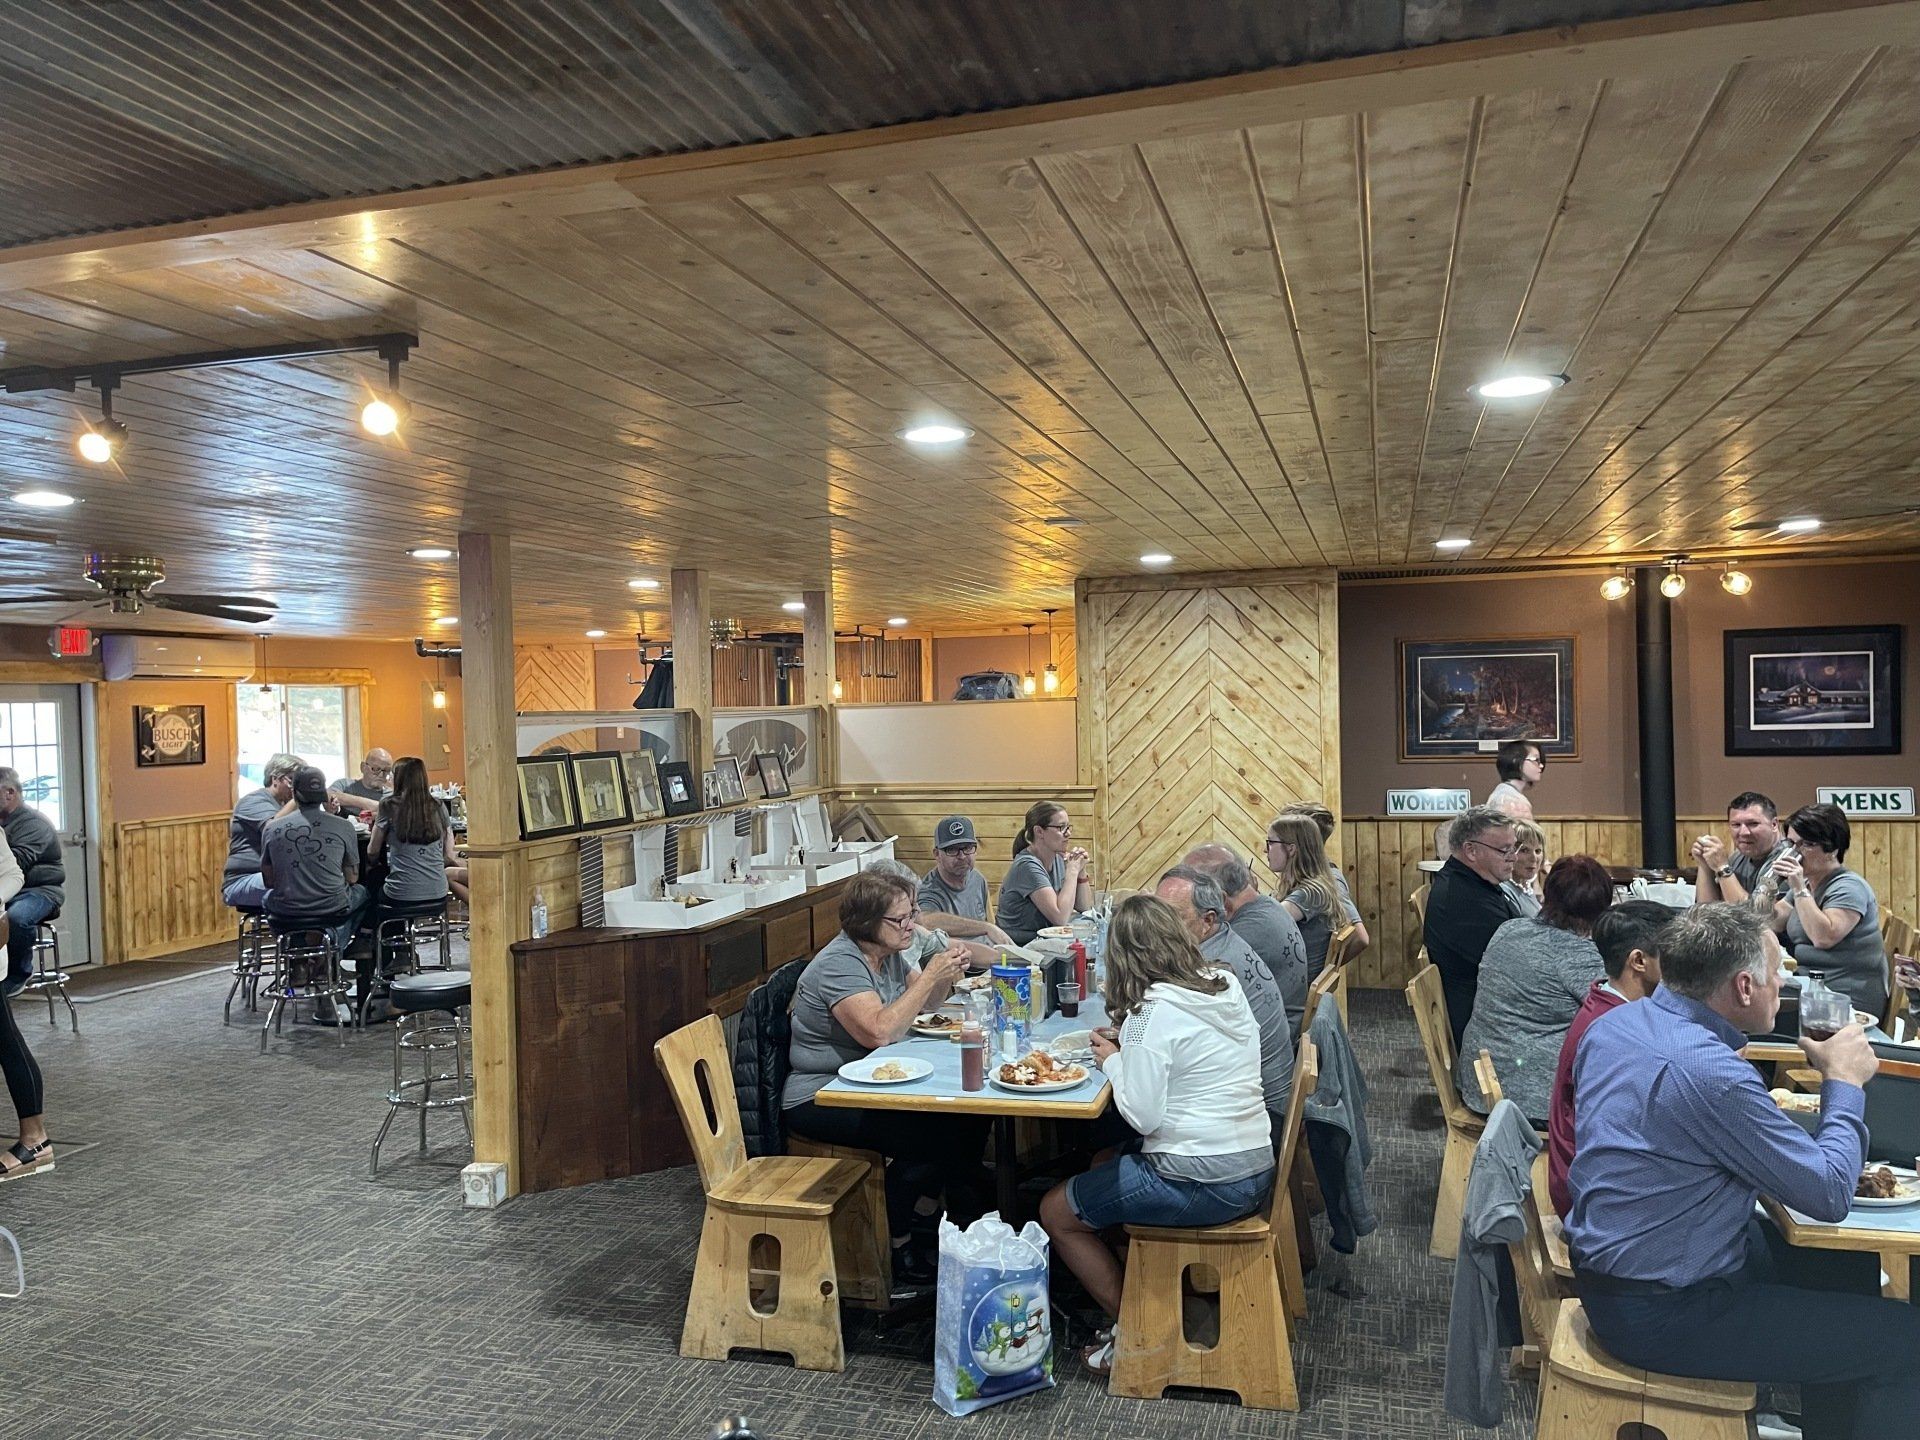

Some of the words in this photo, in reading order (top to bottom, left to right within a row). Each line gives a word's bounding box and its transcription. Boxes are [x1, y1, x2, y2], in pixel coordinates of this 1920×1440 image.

[62, 629, 88, 653] EXIT
[154, 729, 190, 741] BUSCH
[1392, 795, 1467, 810] WOMENS
[1831, 793, 1902, 810] MENS
